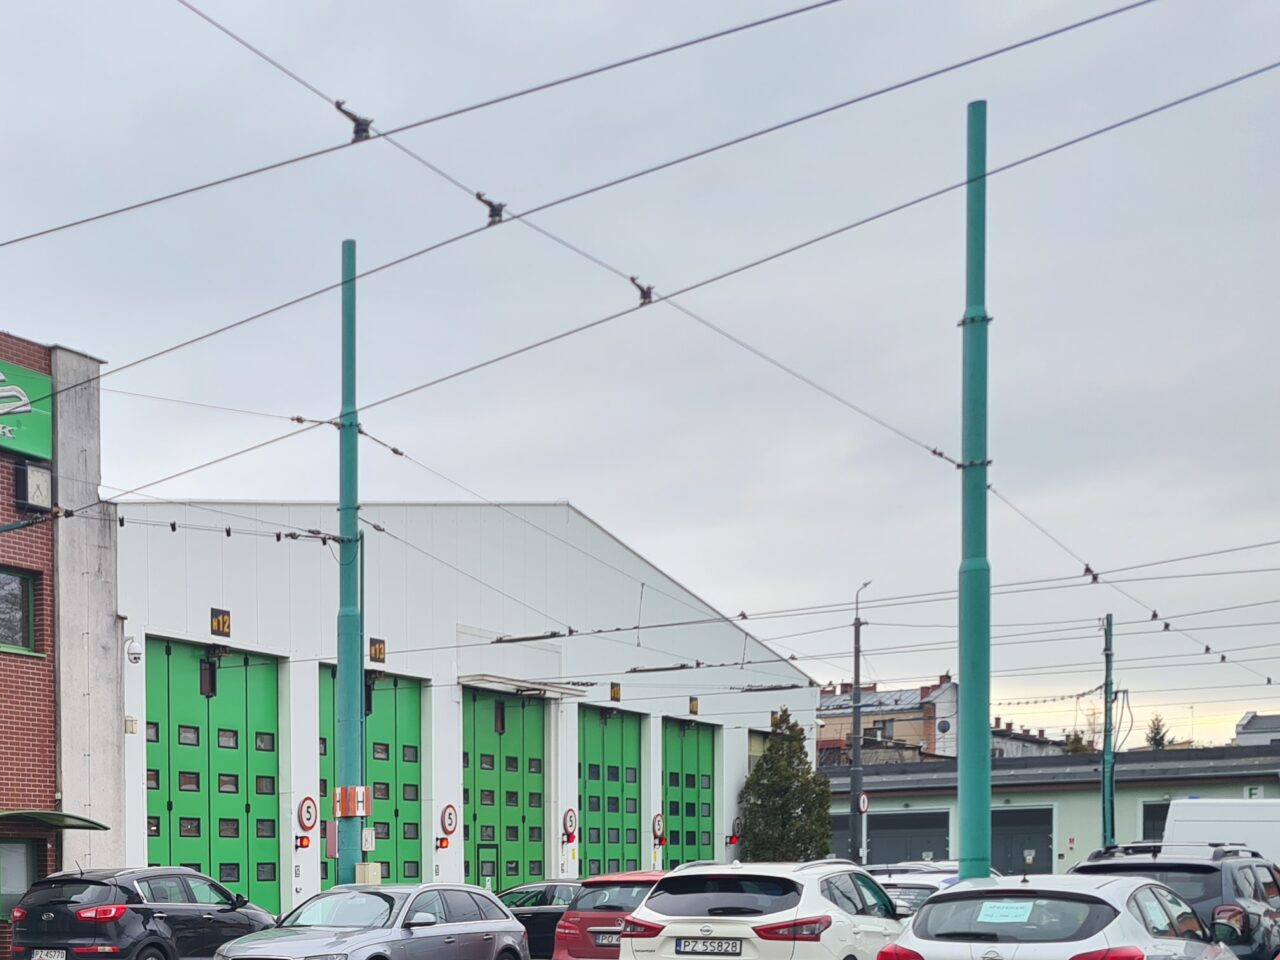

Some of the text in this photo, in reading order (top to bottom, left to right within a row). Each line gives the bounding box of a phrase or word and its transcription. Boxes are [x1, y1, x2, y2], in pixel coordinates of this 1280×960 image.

[305, 805, 312, 821] 5
[447, 812, 453, 827] 5
[683, 940, 698, 952] PZ
